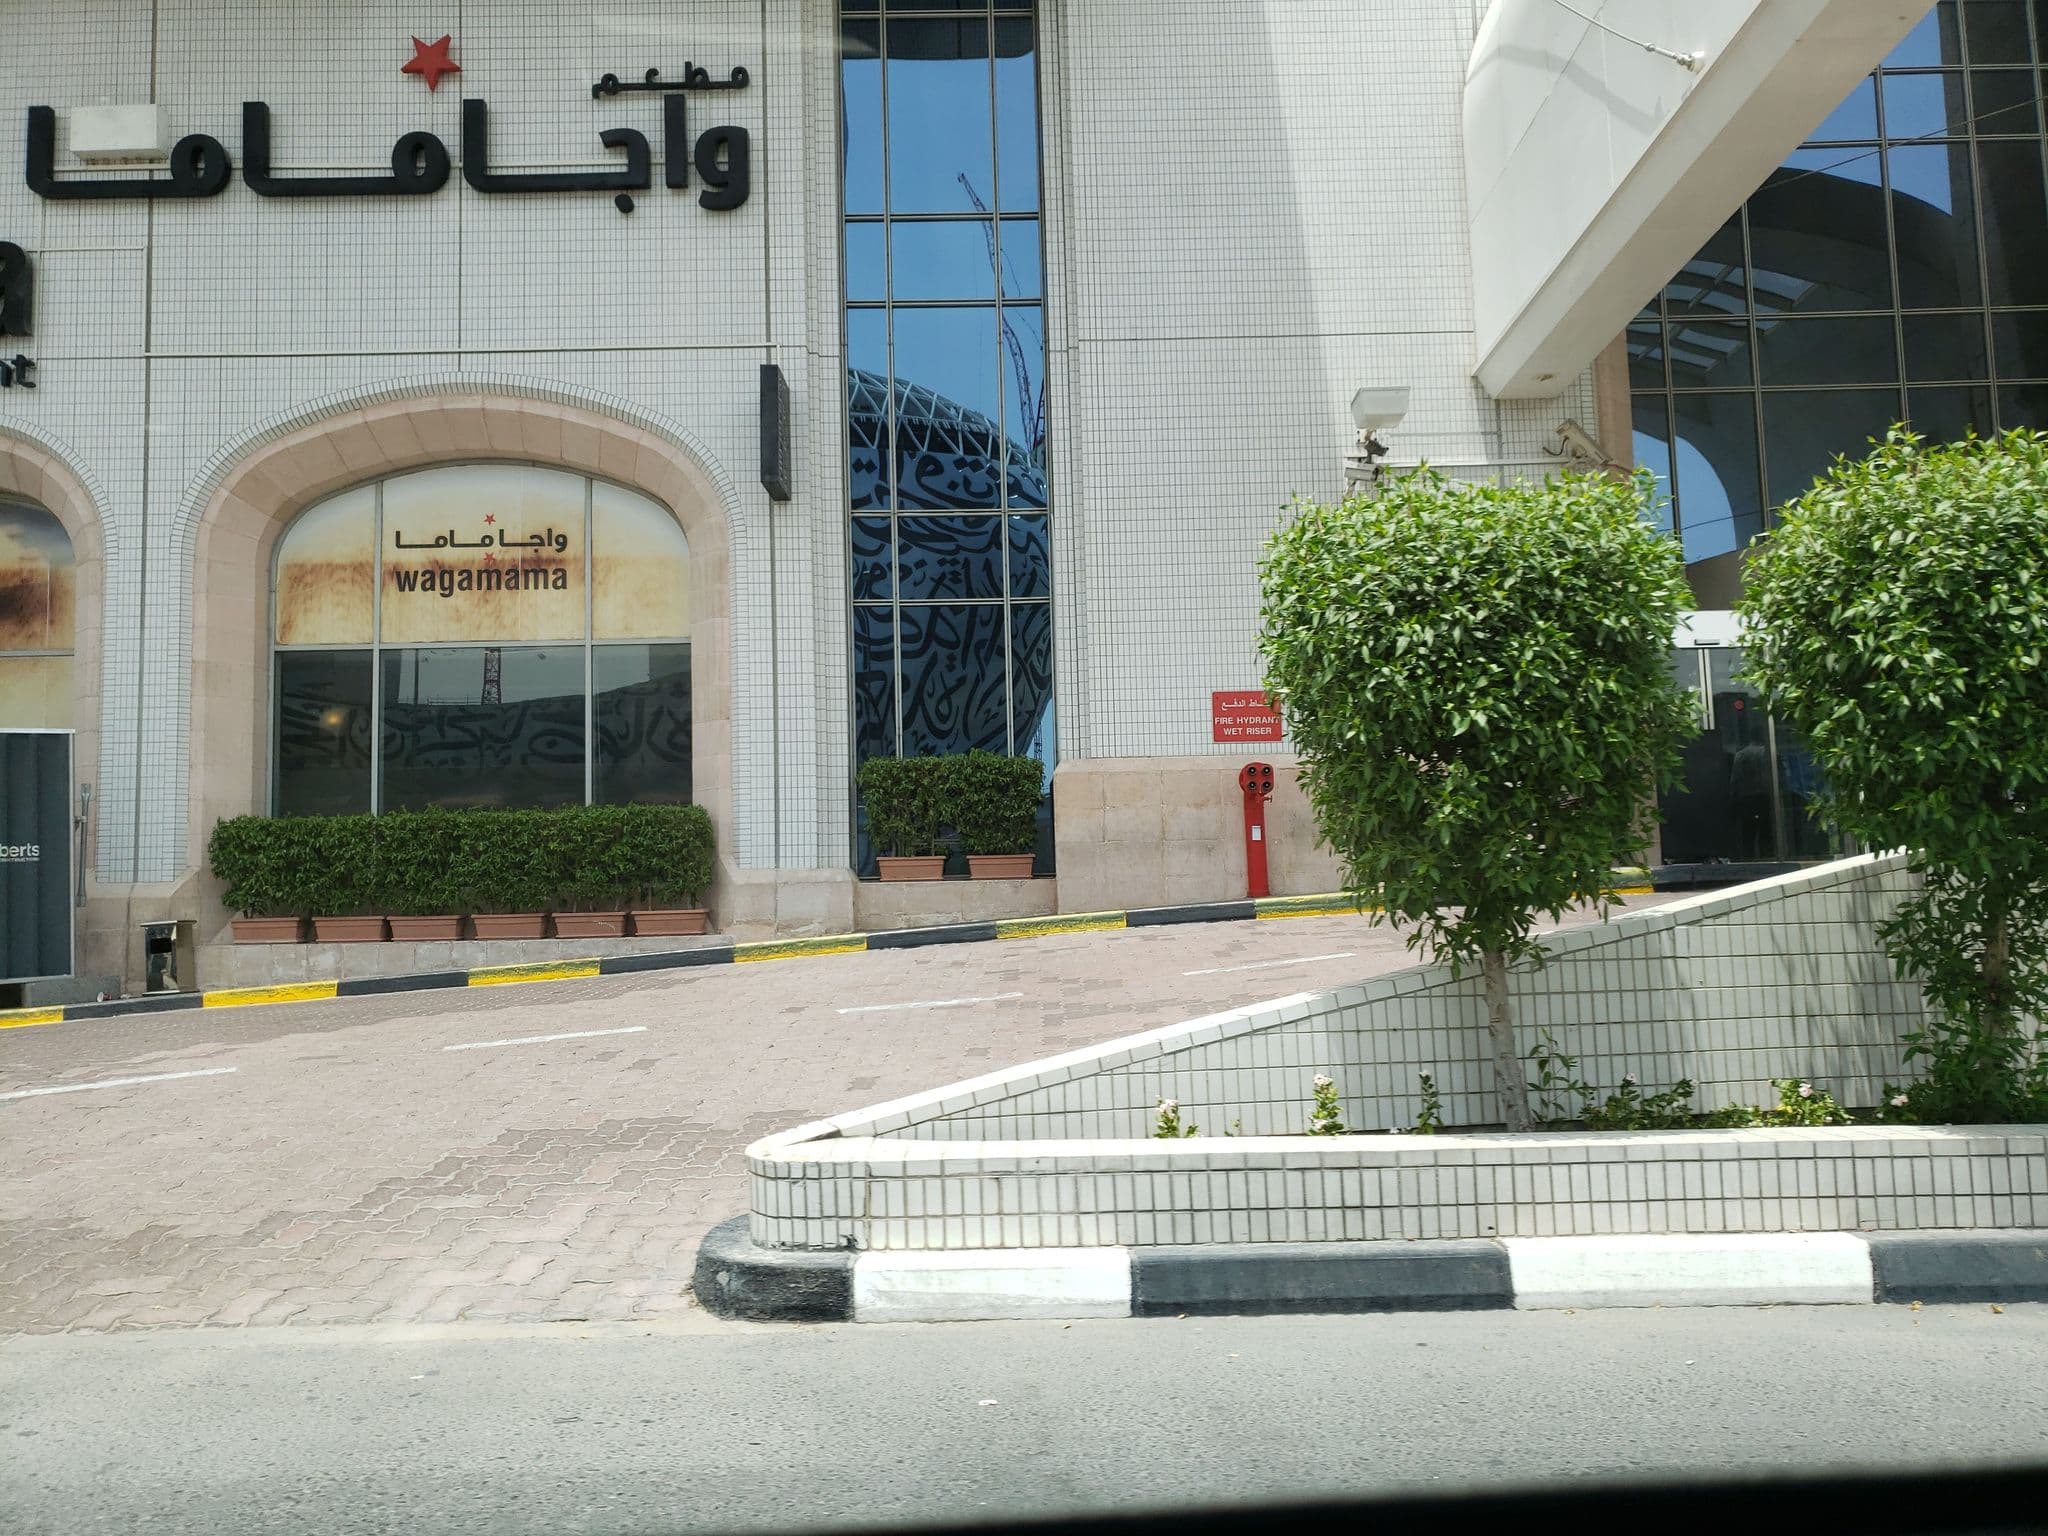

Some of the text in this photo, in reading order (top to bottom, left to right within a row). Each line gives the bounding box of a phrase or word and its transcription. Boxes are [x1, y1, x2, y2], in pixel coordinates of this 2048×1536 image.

[592, 61, 750, 100] مطعم
[25, 94, 751, 213] واجاماما
[395, 528, 568, 553] واجاماما
[395, 567, 568, 597] wagamama
[1214, 716, 1280, 725] FIRE HYDRANT
[1223, 727, 1272, 736] WET RISER
